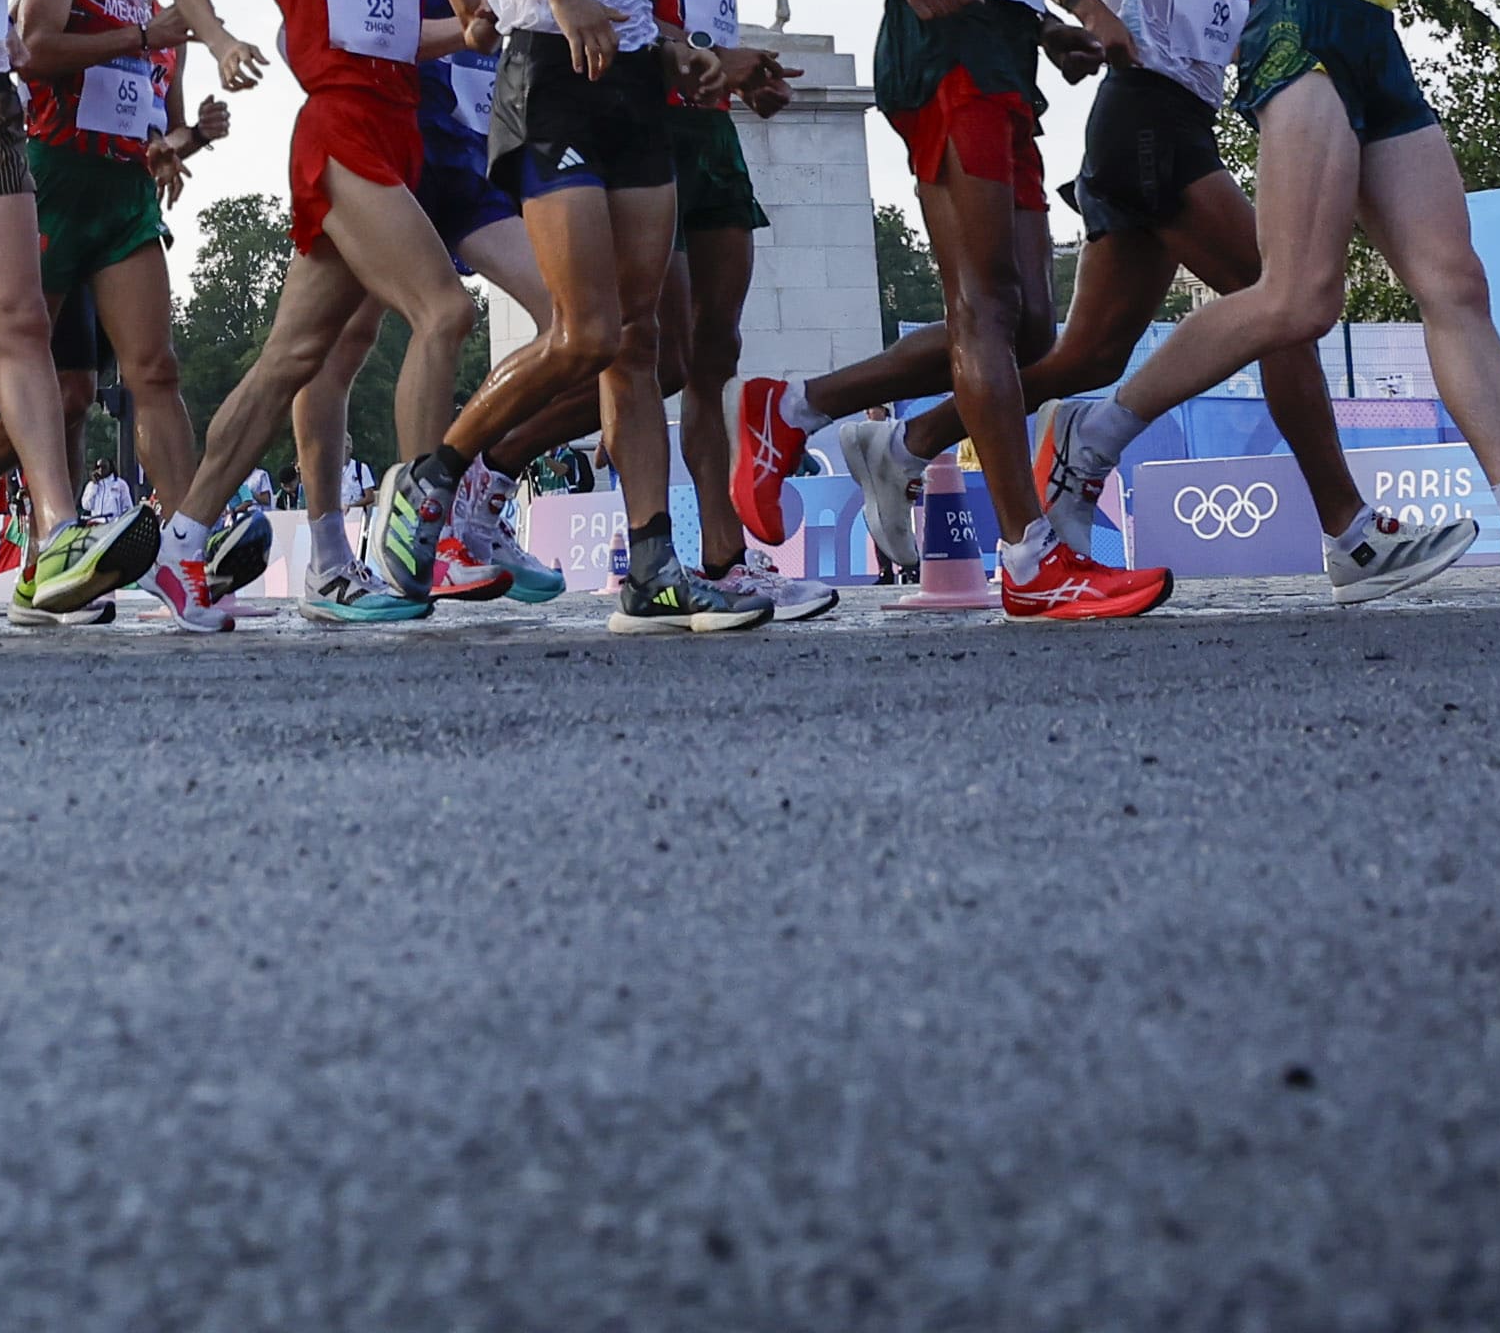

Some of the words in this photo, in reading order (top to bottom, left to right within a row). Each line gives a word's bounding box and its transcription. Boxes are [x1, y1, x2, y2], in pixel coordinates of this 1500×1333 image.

[1211, 2, 1231, 27] 29
[118, 79, 138, 102] 65
[950, 527, 978, 542] 20
